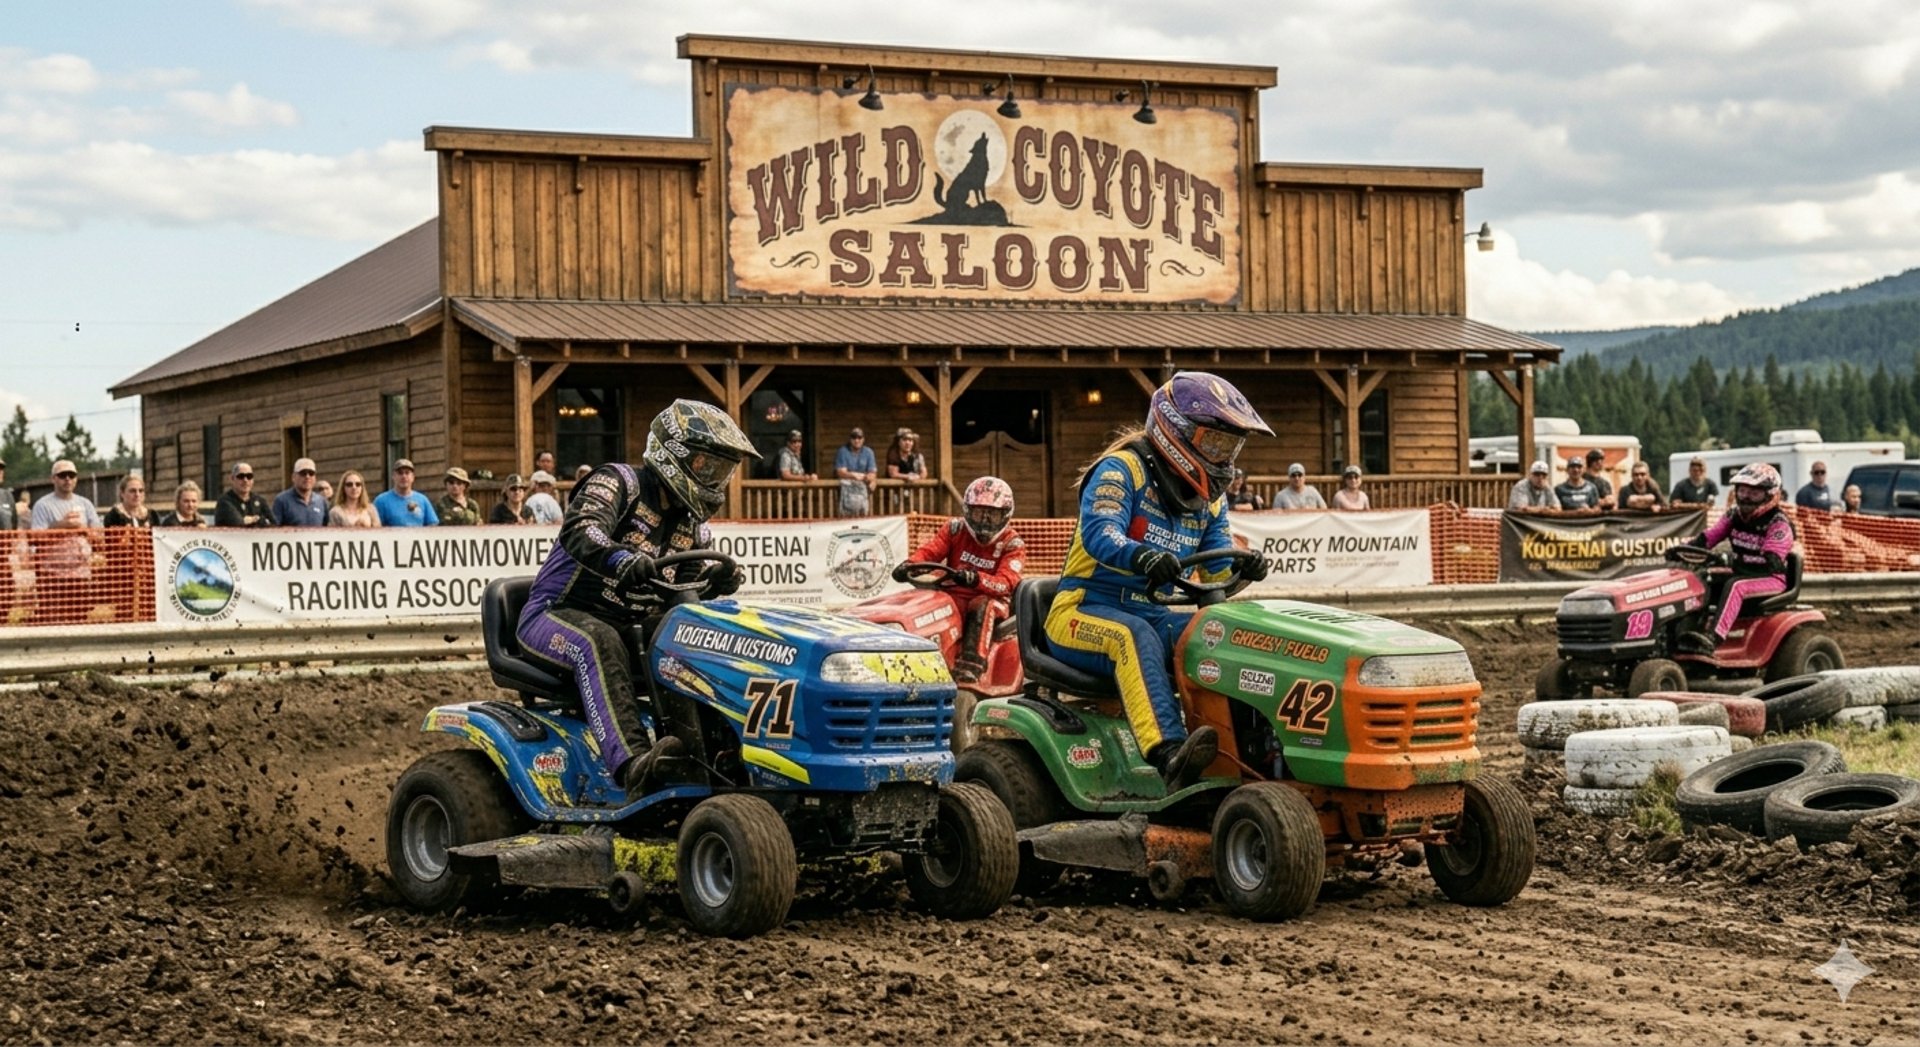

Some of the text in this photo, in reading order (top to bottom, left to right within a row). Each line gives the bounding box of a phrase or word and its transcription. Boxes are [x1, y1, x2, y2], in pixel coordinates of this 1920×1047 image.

[746, 124, 1226, 265] WILD COYOTE
[828, 228, 1154, 292] SALOON
[252, 540, 385, 571] MONTANA
[711, 536, 810, 557] OOTENAI
[1263, 536, 1419, 554] ROCKY MOUNTAIN
[1611, 536, 1692, 558] CUSTOM
[288, 577, 489, 610] RACING ASSOC
[742, 677, 799, 739] 71
[1276, 678, 1336, 735] 42
